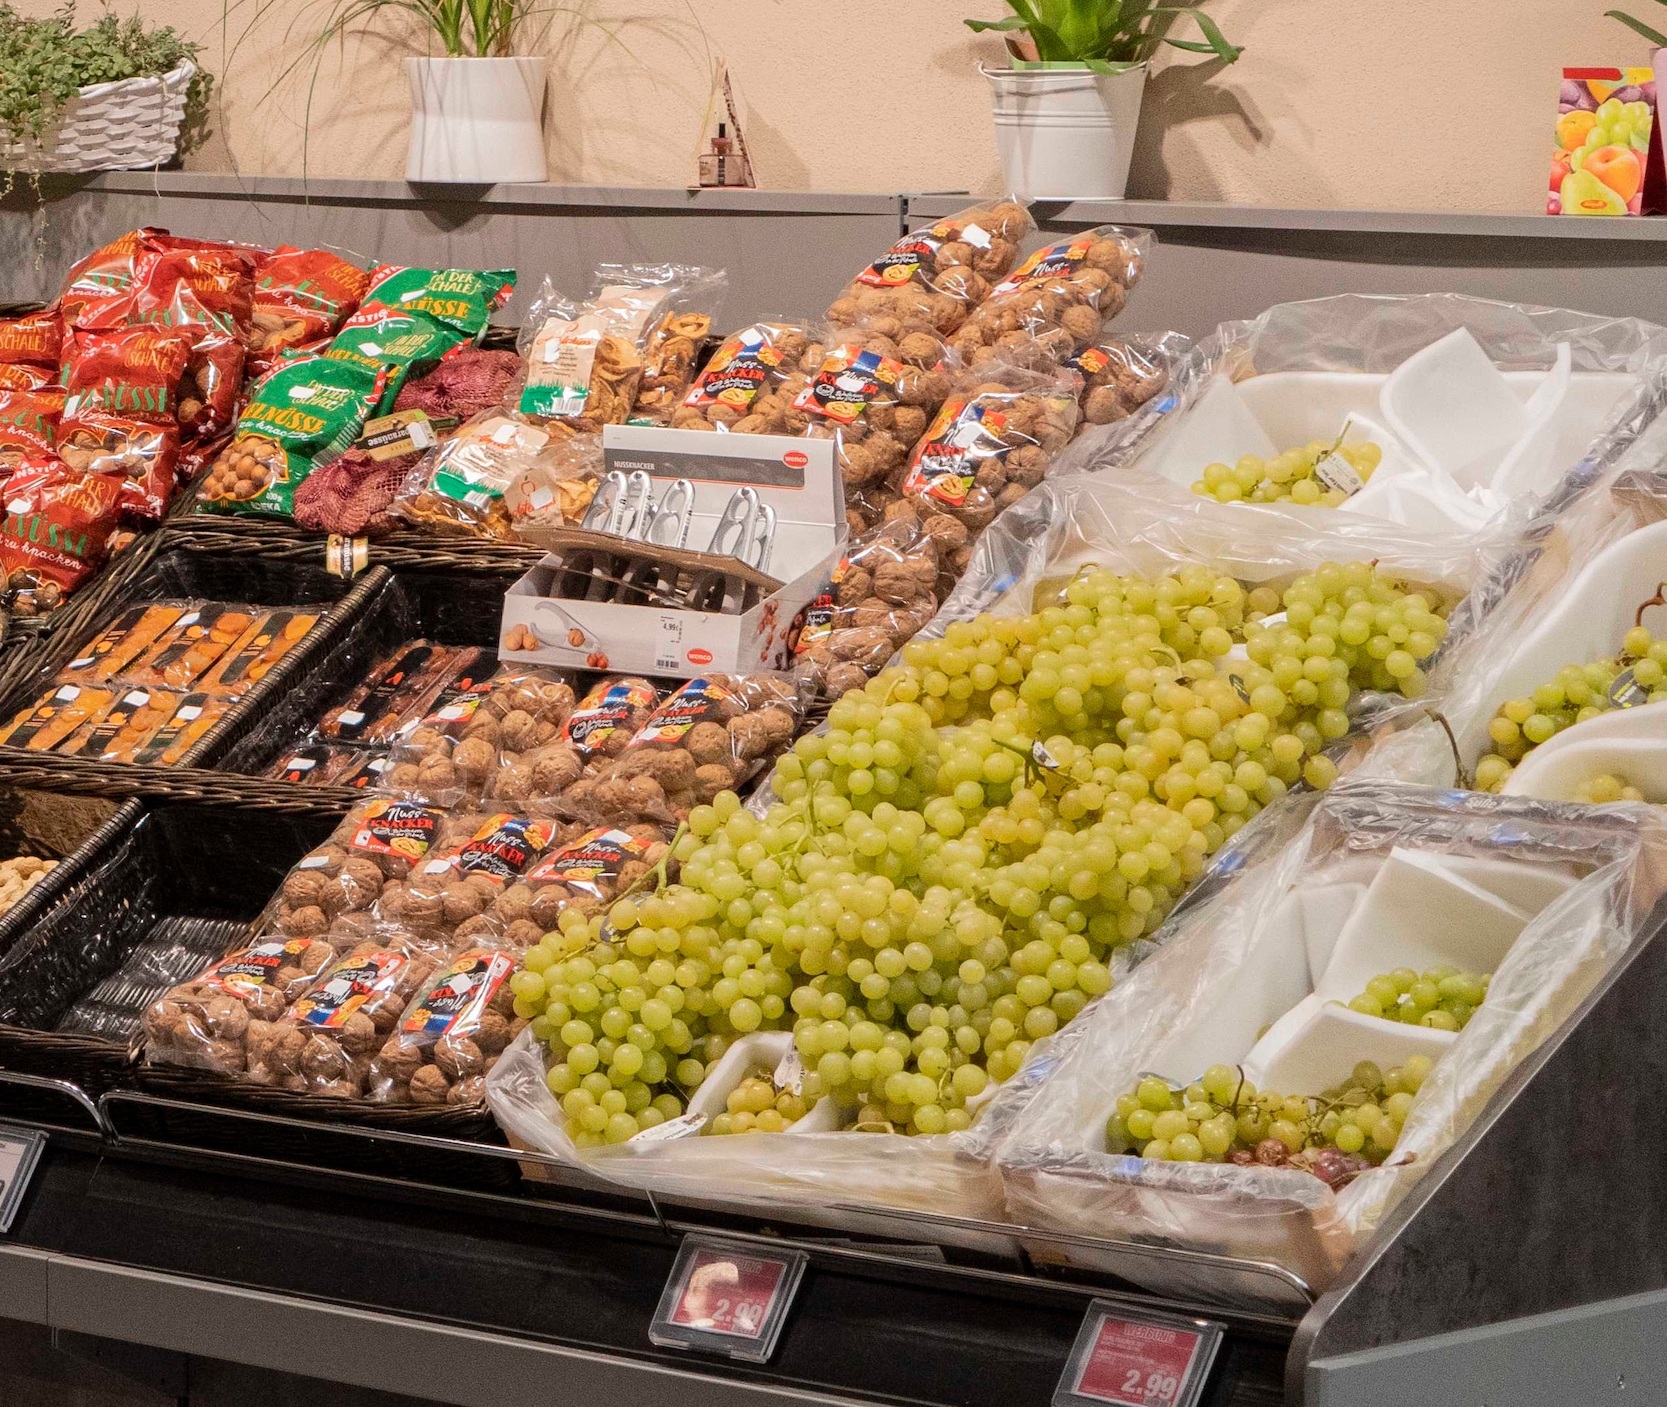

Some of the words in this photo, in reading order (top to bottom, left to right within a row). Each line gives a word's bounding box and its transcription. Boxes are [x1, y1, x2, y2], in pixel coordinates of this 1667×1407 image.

[727, 359, 762, 373] Nuss-
[818, 372, 879, 396] KNER
[614, 460, 655, 471] NUSSKNACKER
[784, 454, 808, 464] wenco
[21, 540, 83, 571] knacken
[688, 652, 712, 662] wenco
[387, 807, 429, 821] Nuss-
[370, 819, 434, 831] KNACKER
[487, 830, 527, 849] Nuss-
[712, 1298, 764, 1326] 2.99
[1123, 1322, 1177, 1344] WERBUNG
[1120, 1368, 1178, 1401] 2.99
